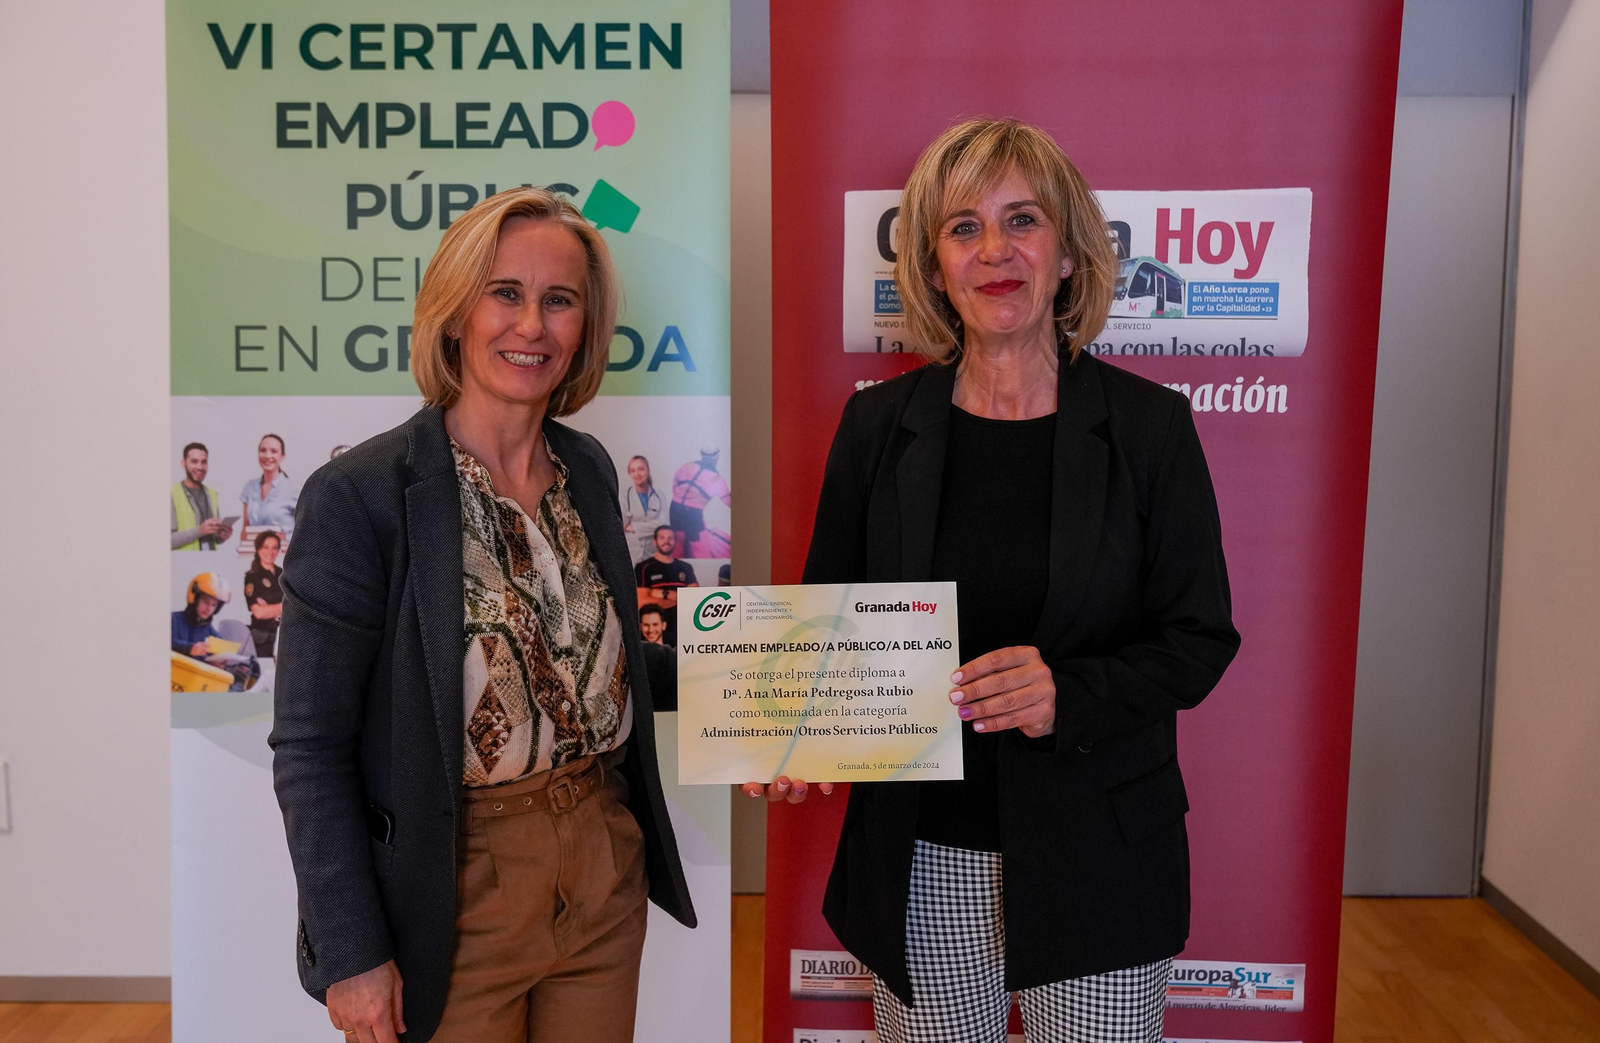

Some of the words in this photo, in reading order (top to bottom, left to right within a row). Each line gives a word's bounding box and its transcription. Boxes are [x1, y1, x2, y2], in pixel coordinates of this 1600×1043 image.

[207, 23, 273, 70] VI
[299, 22, 682, 71] CERTAMEN
[347, 170, 580, 231] PÚB
[1154, 208, 1275, 279] Hoy
[1192, 285, 1201, 294] El
[1202, 285, 1221, 294] Año
[1222, 285, 1248, 294] Lorca
[1249, 286, 1270, 296] pone
[1192, 295, 1203, 303] en
[1203, 295, 1234, 303] marcha
[1235, 295, 1243, 303] la
[1244, 296, 1274, 304] carrera
[1192, 304, 1206, 314] por
[1207, 304, 1215, 312] la
[1215, 304, 1261, 314] Capitalidad
[874, 321, 900, 329] NUEVO
[1113, 323, 1152, 331] SERVICIO
[235, 325, 318, 372] EN
[1120, 342, 1164, 356] con
[1170, 336, 1206, 356] las
[1210, 337, 1275, 357] colas
[855, 601, 910, 613] Granada
[912, 600, 938, 615] Hoy
[683, 645, 694, 654] VI
[697, 643, 757, 654] CERTAMEN
[760, 641, 835, 653] EMPLEADO/A
[838, 638, 901, 652] PÚBLICO/A
[903, 640, 923, 650] DEL
[925, 637, 953, 650] AÑO
[730, 669, 743, 681] Se
[745, 671, 782, 683] otorga
[784, 668, 795, 679] el
[797, 669, 847, 683] presente
[848, 666, 896, 681] diploma
[898, 669, 906, 678] a
[744, 688, 769, 699] Ana
[771, 687, 809, 699] María
[811, 686, 874, 701] Pedregosa
[876, 685, 914, 697] Rubio
[729, 710, 761, 719] como
[763, 706, 822, 718] nominada
[824, 708, 839, 717] en
[841, 705, 851, 717] la
[853, 704, 908, 719] categoría
[700, 725, 831, 738] Administración/Otros
[832, 724, 887, 736] Servicios
[888, 723, 938, 735] Públicos
[837, 762, 872, 770] Granada,
[912, 761, 922, 769] de
[800, 959, 856, 975] DIARIO
[1168, 967, 1272, 985] uropaSur
